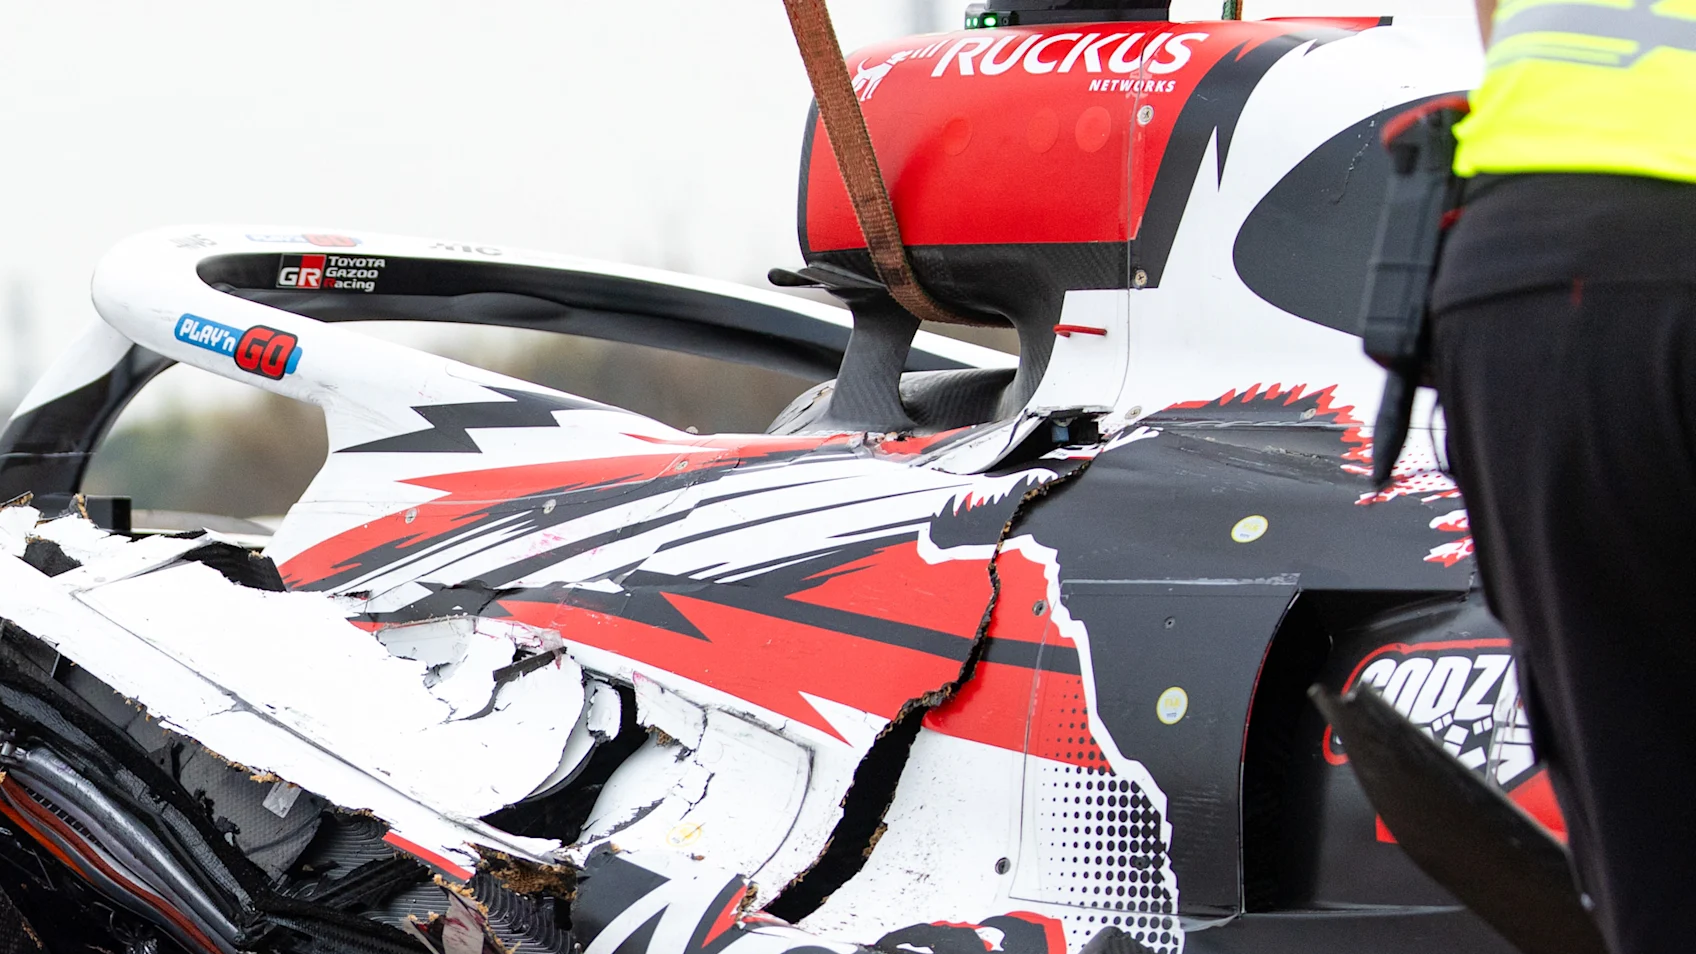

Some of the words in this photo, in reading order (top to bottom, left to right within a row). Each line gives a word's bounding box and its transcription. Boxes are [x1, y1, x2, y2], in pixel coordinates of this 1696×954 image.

[930, 32, 1209, 77] RUCKUS
[1089, 79, 1176, 93] NETWORKS
[328, 256, 386, 269] TOYOTA
[278, 267, 322, 287] GR
[325, 267, 379, 279] GAZOO
[324, 278, 375, 292] Racing
[237, 329, 297, 377] GO
